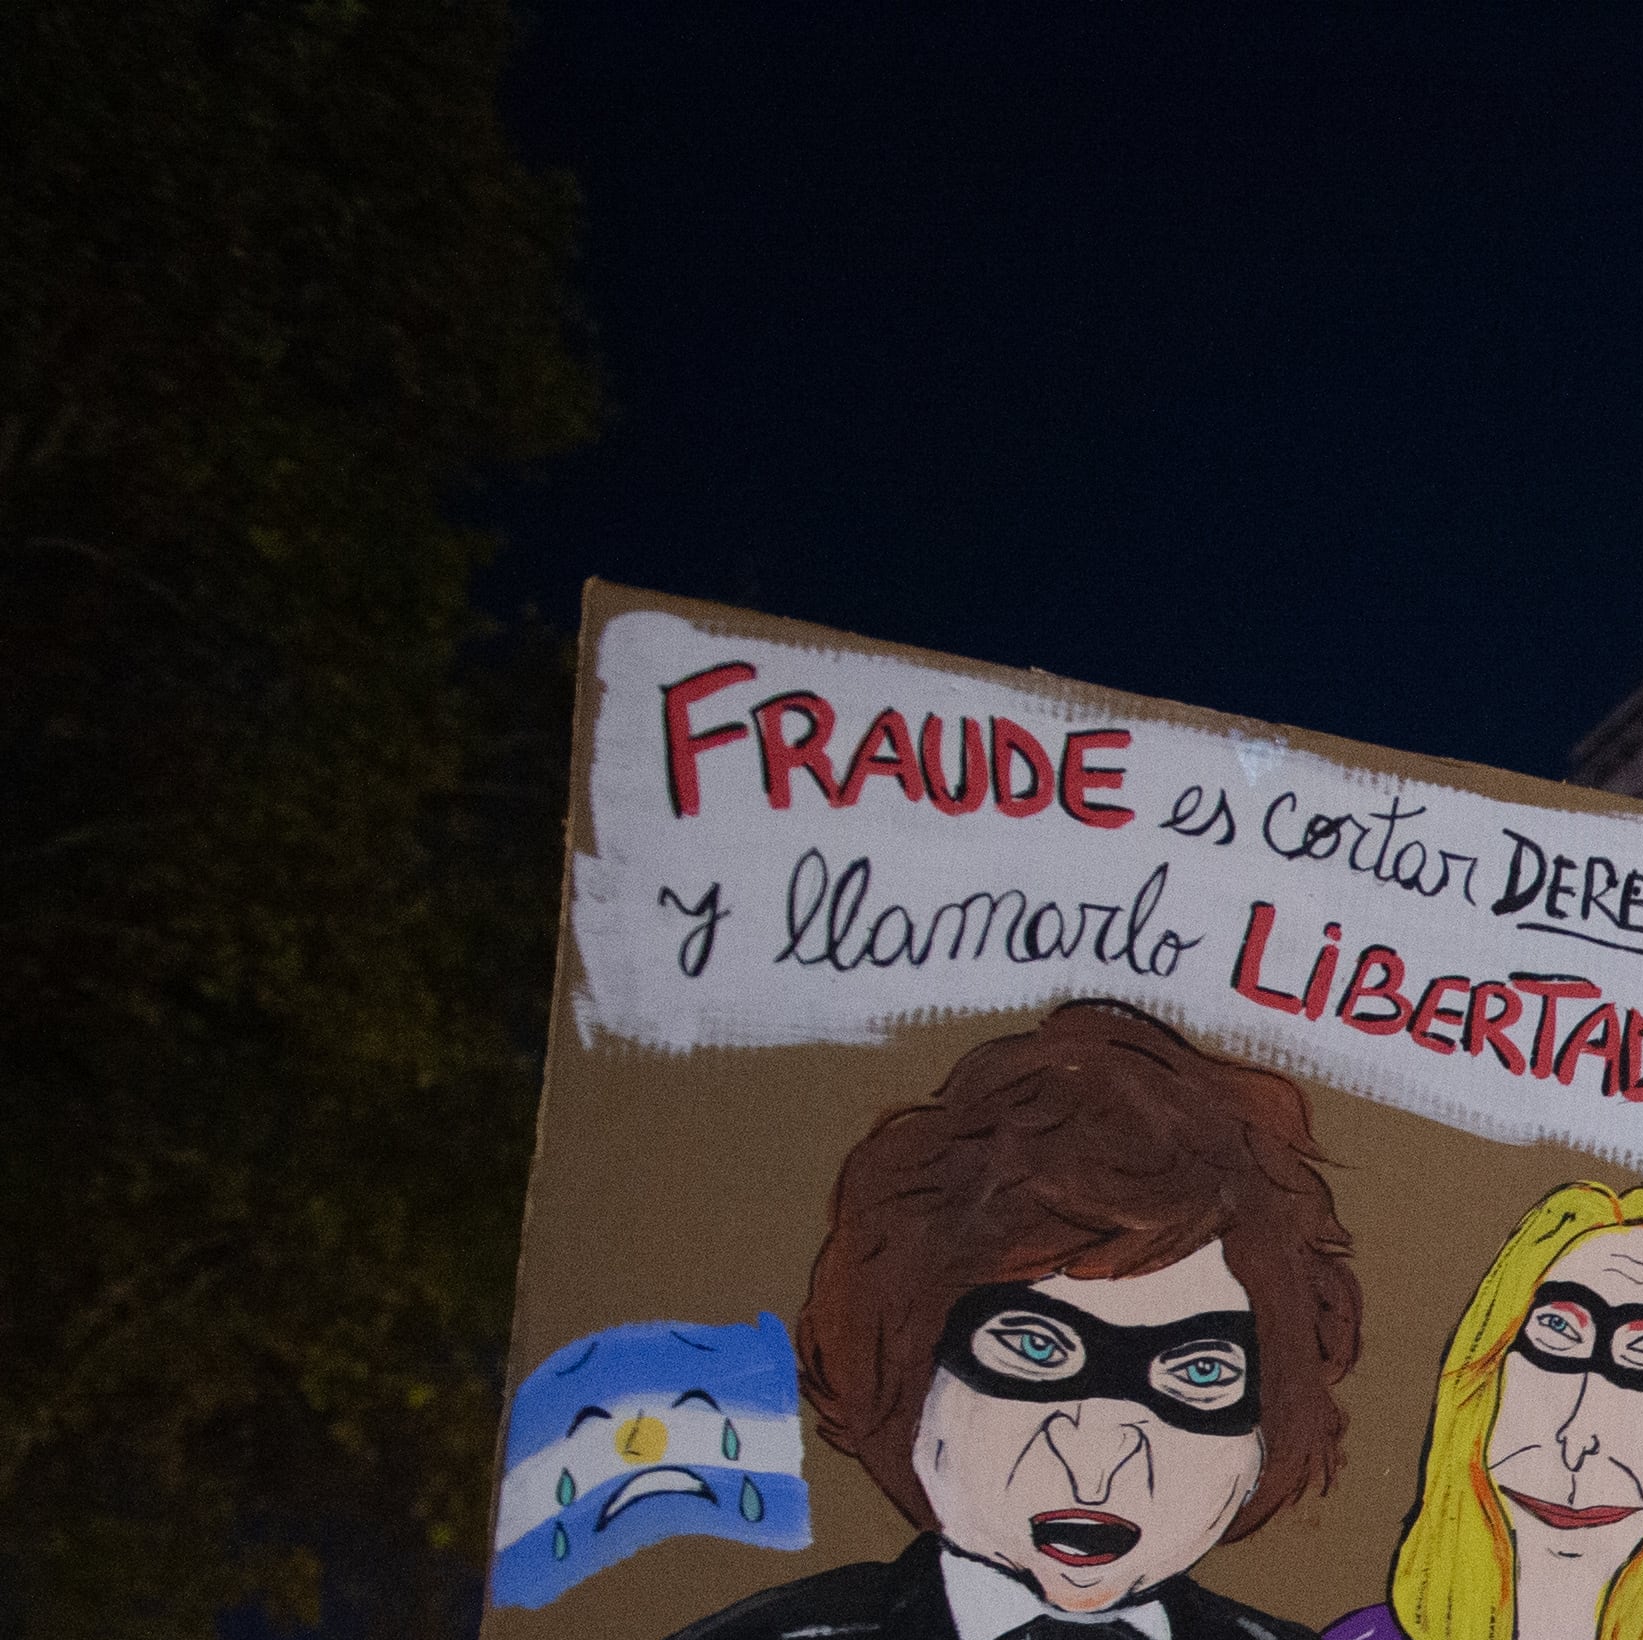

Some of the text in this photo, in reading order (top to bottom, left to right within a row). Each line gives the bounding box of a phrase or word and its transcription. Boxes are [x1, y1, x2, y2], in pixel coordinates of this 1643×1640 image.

[661, 663, 1134, 828] FRAUDE
[1160, 781, 1237, 848] es
[1261, 788, 1480, 905] cortar
[657, 877, 730, 979] y
[774, 846, 1205, 979] llamarlo
